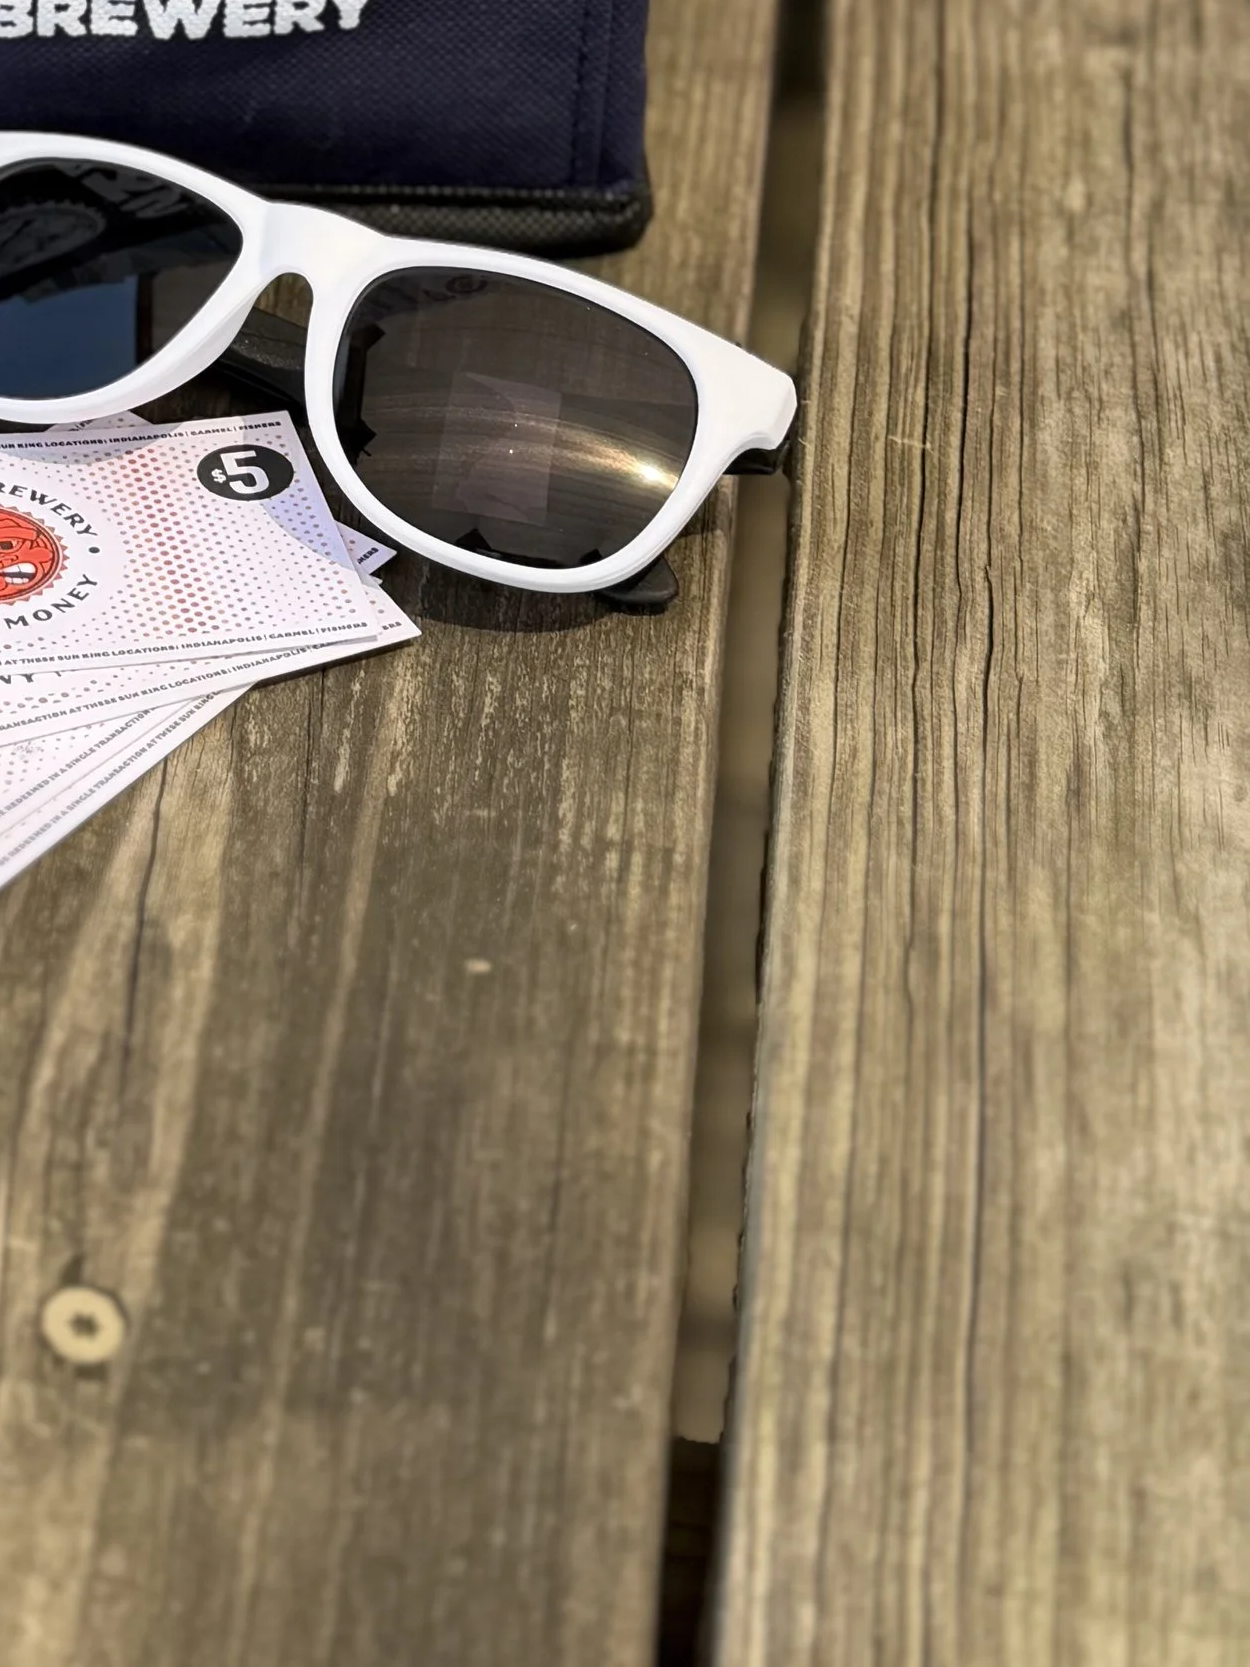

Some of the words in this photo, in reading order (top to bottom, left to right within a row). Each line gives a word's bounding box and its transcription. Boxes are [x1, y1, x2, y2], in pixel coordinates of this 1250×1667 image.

[16, 441, 43, 449] KING
[44, 437, 107, 448] LOCATIONS:
[108, 430, 184, 443] INDIANAPOLIS
[190, 426, 233, 436] CARMEL
[238, 420, 281, 431] FISHERS
[211, 450, 270, 495] $5
[3, 574, 99, 630] MONEY
[18, 655, 55, 665] THESE
[57, 653, 80, 661] SUN
[82, 650, 110, 659] KING
[111, 643, 179, 657] LOCATIONS:
[180, 635, 262, 649] INDIANAPOLIS
[268, 628, 315, 639] CARMEL
[319, 621, 368, 633] FISHERS
[82, 696, 117, 711] THESE
[117, 691, 139, 702] SUN
[140, 683, 168, 696] KING
[168, 667, 232, 689] LOCATIONS:
[231, 646, 307, 671] INDIANAPOLIS
